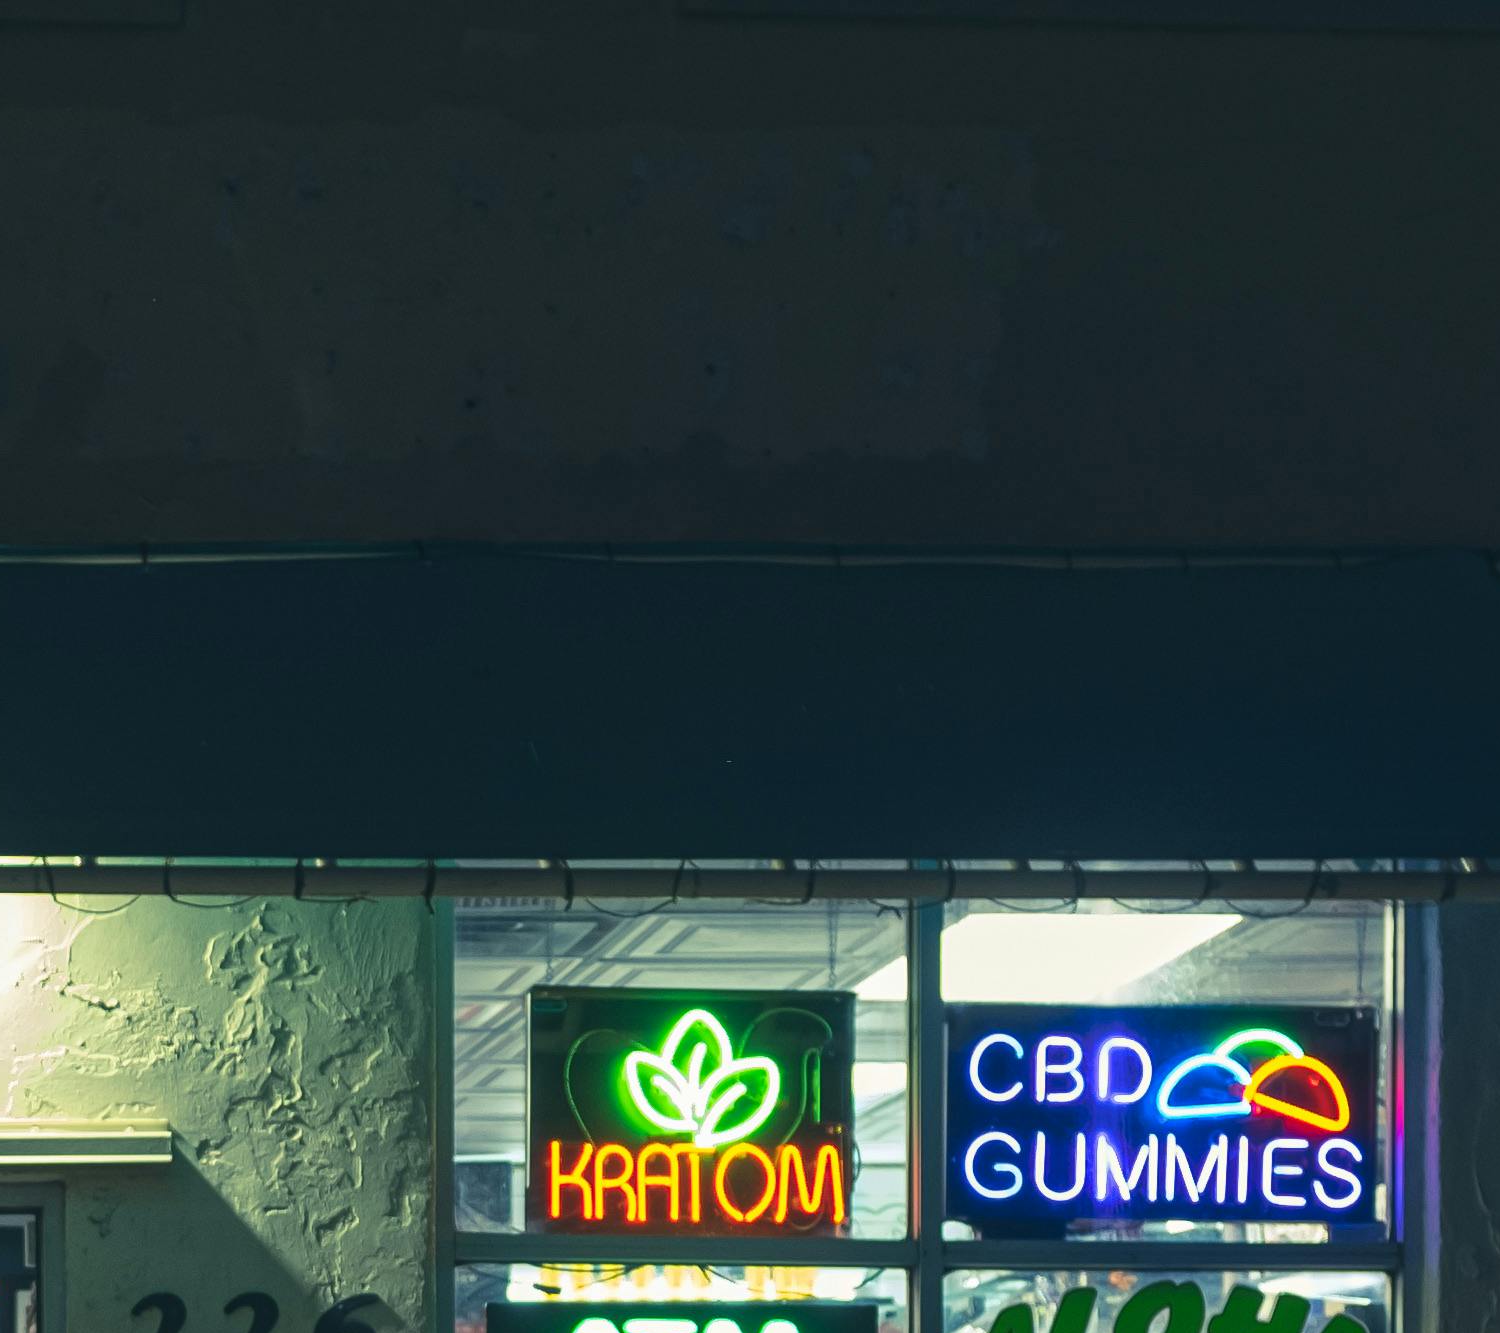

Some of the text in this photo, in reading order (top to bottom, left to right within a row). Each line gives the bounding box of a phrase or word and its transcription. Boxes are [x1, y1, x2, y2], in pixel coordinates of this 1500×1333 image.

[968, 1033, 1153, 1103] CBD
[549, 1140, 845, 1224] KRATOM
[964, 1130, 1364, 1210] GUMMIES
